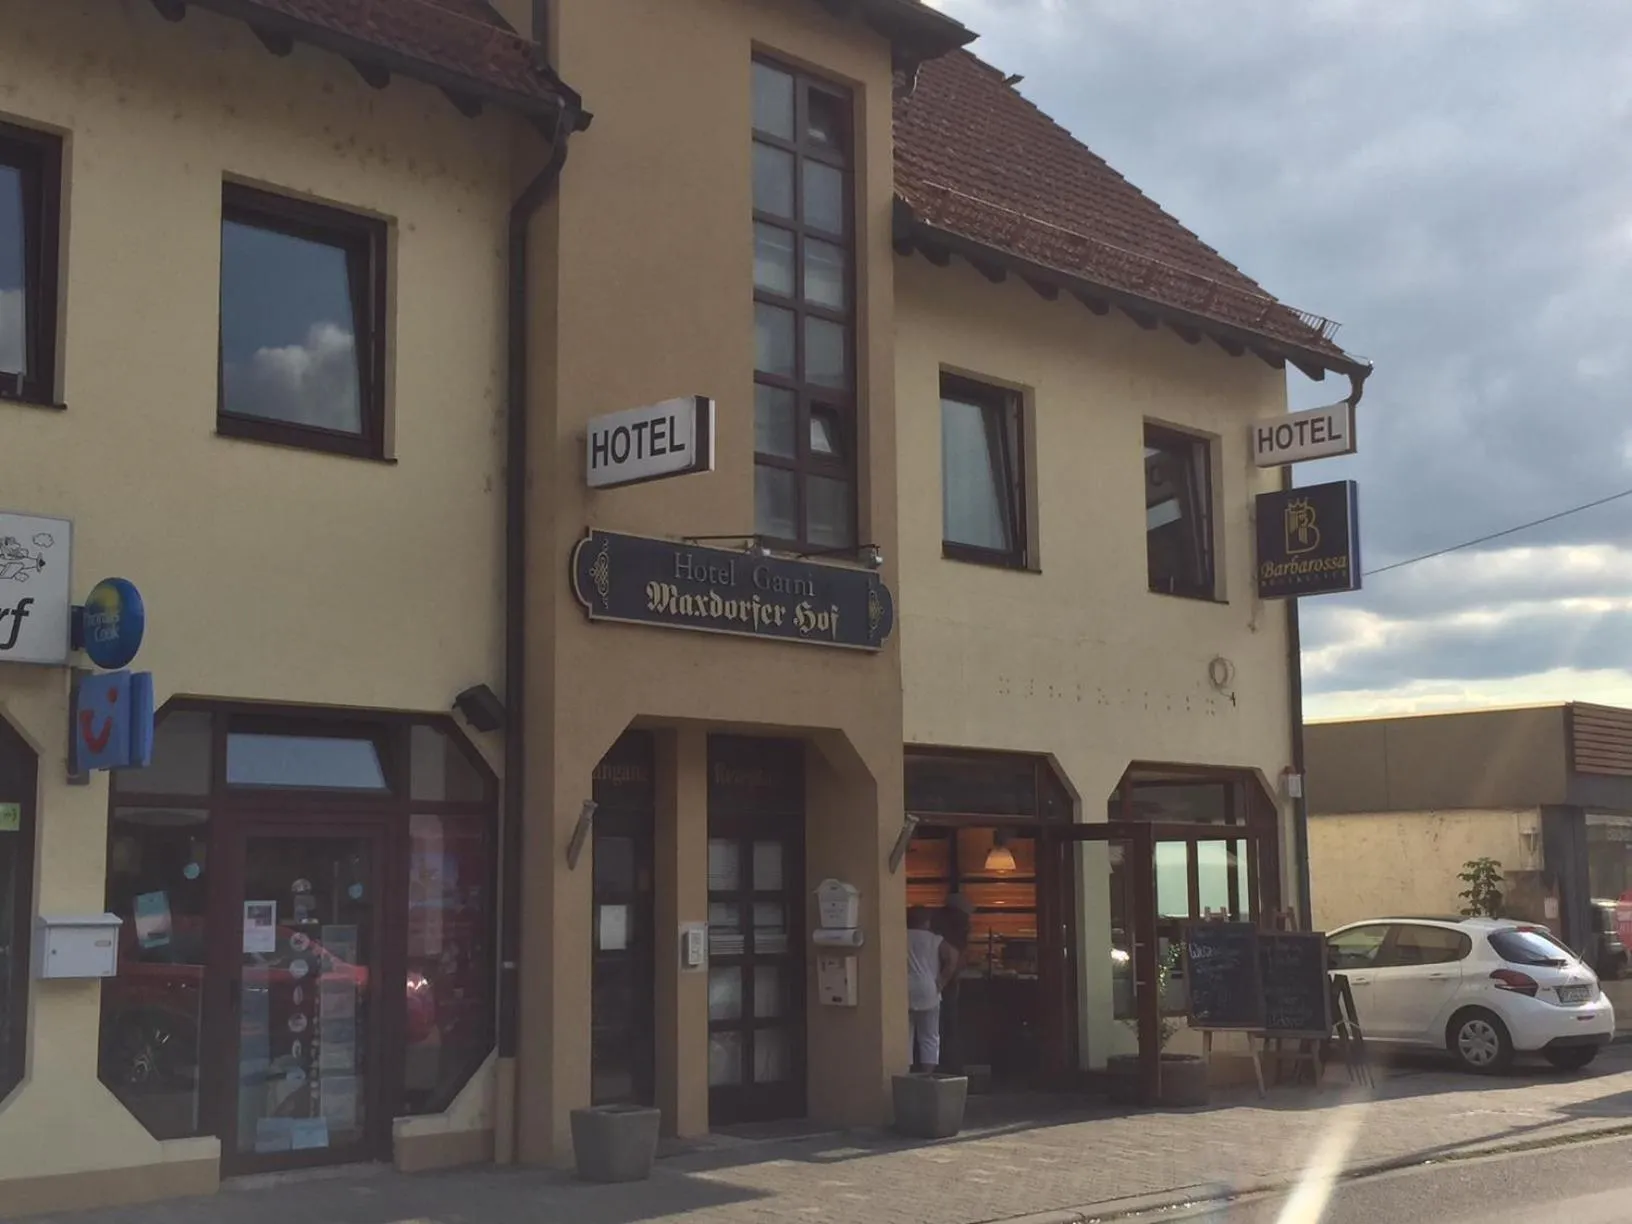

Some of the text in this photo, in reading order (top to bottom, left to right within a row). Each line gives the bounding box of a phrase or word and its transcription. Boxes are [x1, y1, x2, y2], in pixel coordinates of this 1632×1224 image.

[591, 415, 685, 469] HOTEL
[1257, 415, 1342, 453] HOTEL
[674, 552, 816, 597] Hotel Garni
[1260, 554, 1347, 579] Barbarossa
[645, 580, 840, 640] Maxdorfer Hof
